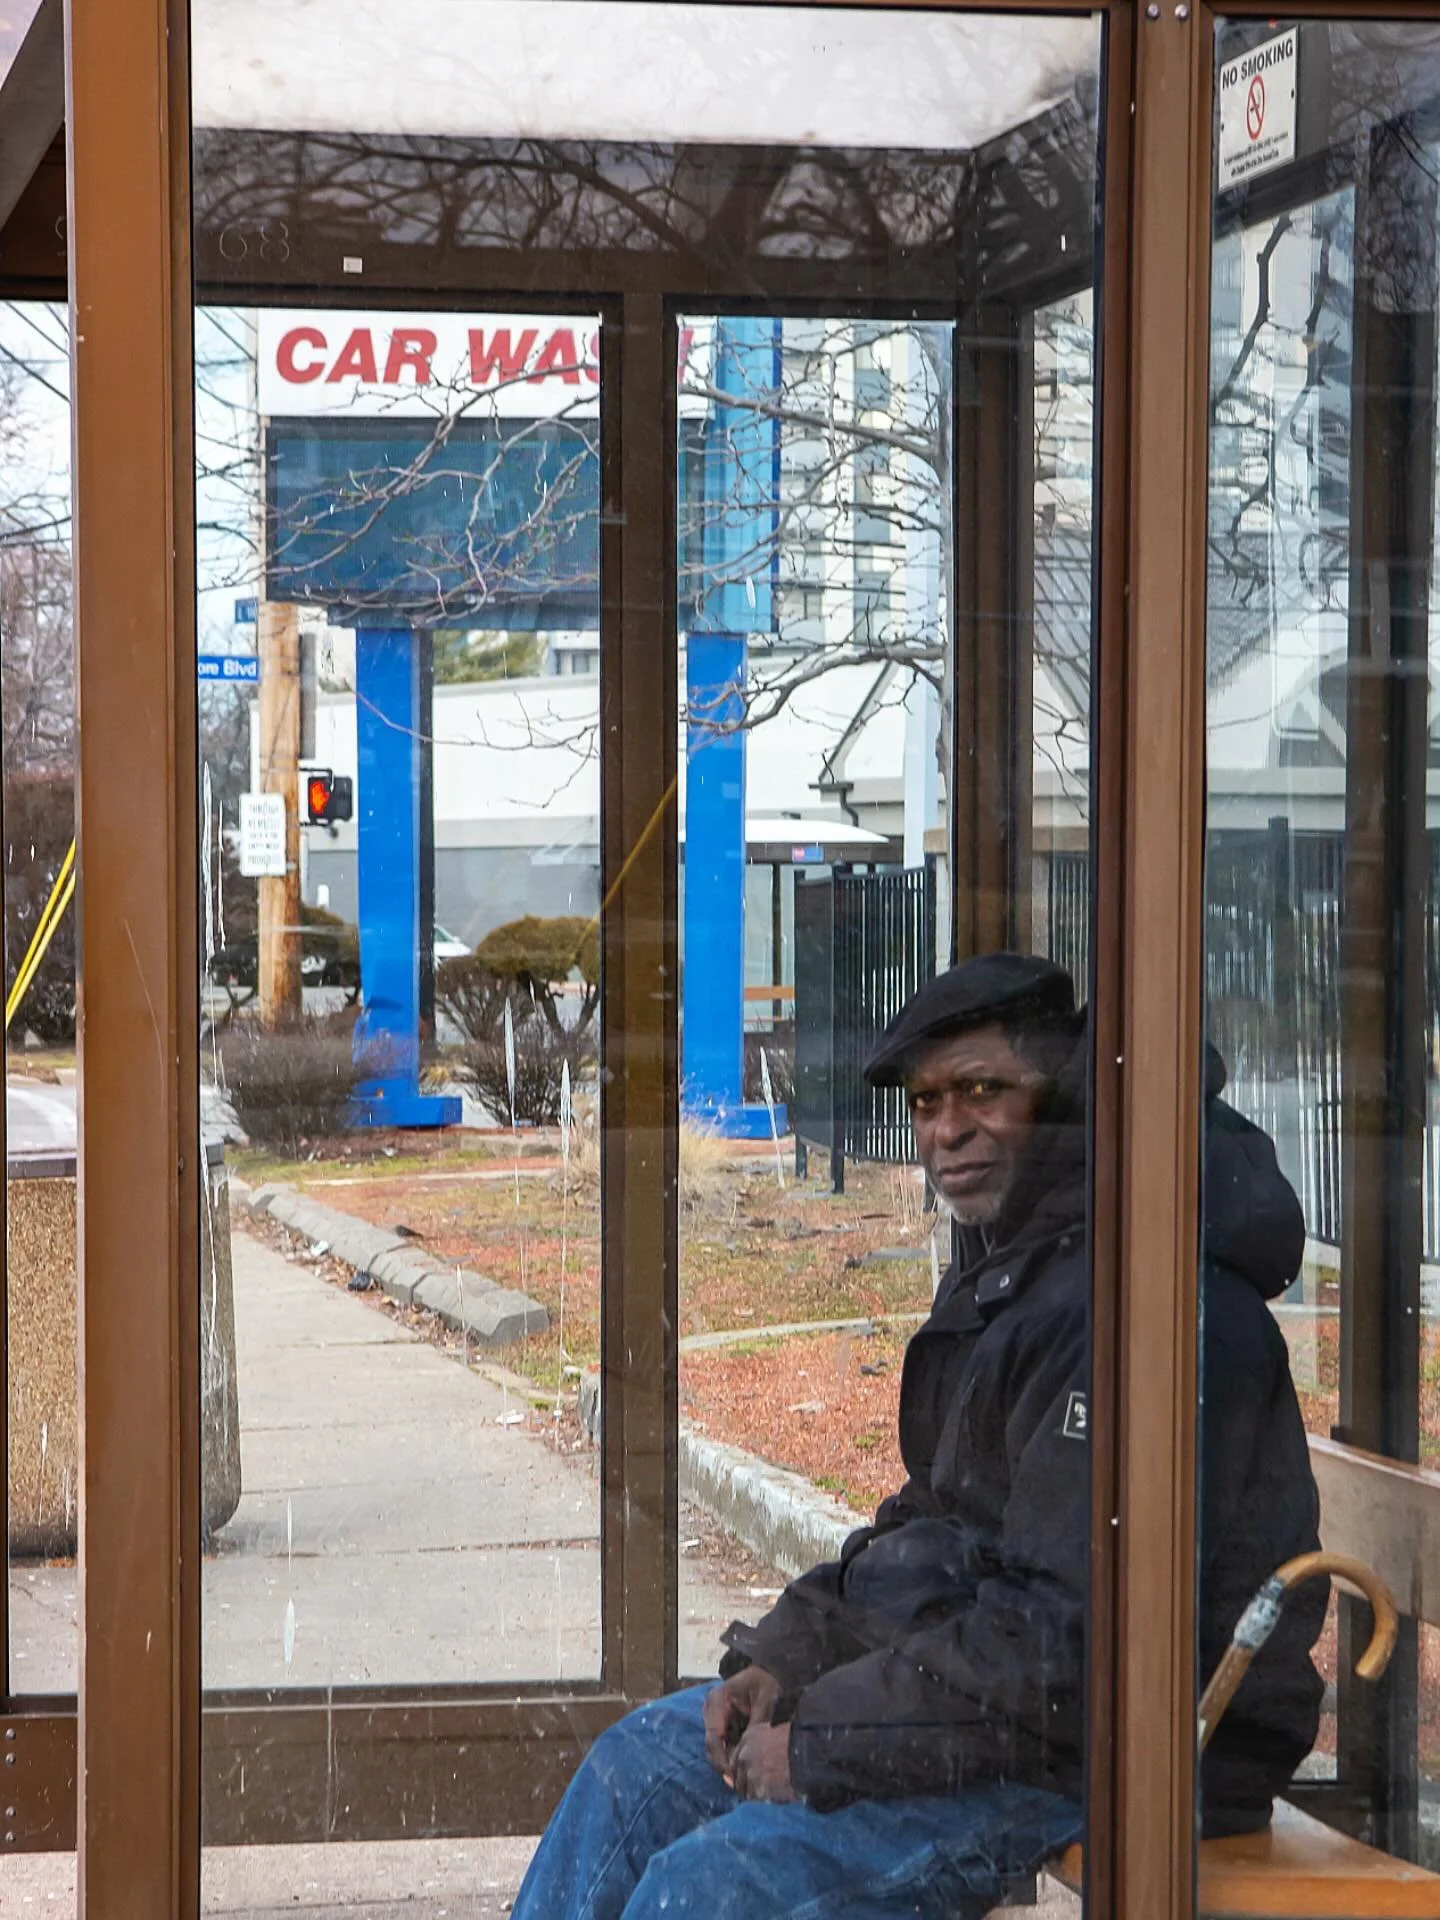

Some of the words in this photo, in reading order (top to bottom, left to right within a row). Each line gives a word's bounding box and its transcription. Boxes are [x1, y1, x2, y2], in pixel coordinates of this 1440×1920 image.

[1222, 66, 1238, 91] NO
[1240, 38, 1293, 80] SMOKING
[275, 326, 438, 385] CAR
[467, 328, 694, 386] WA
[223, 658, 257, 677] Blvd
